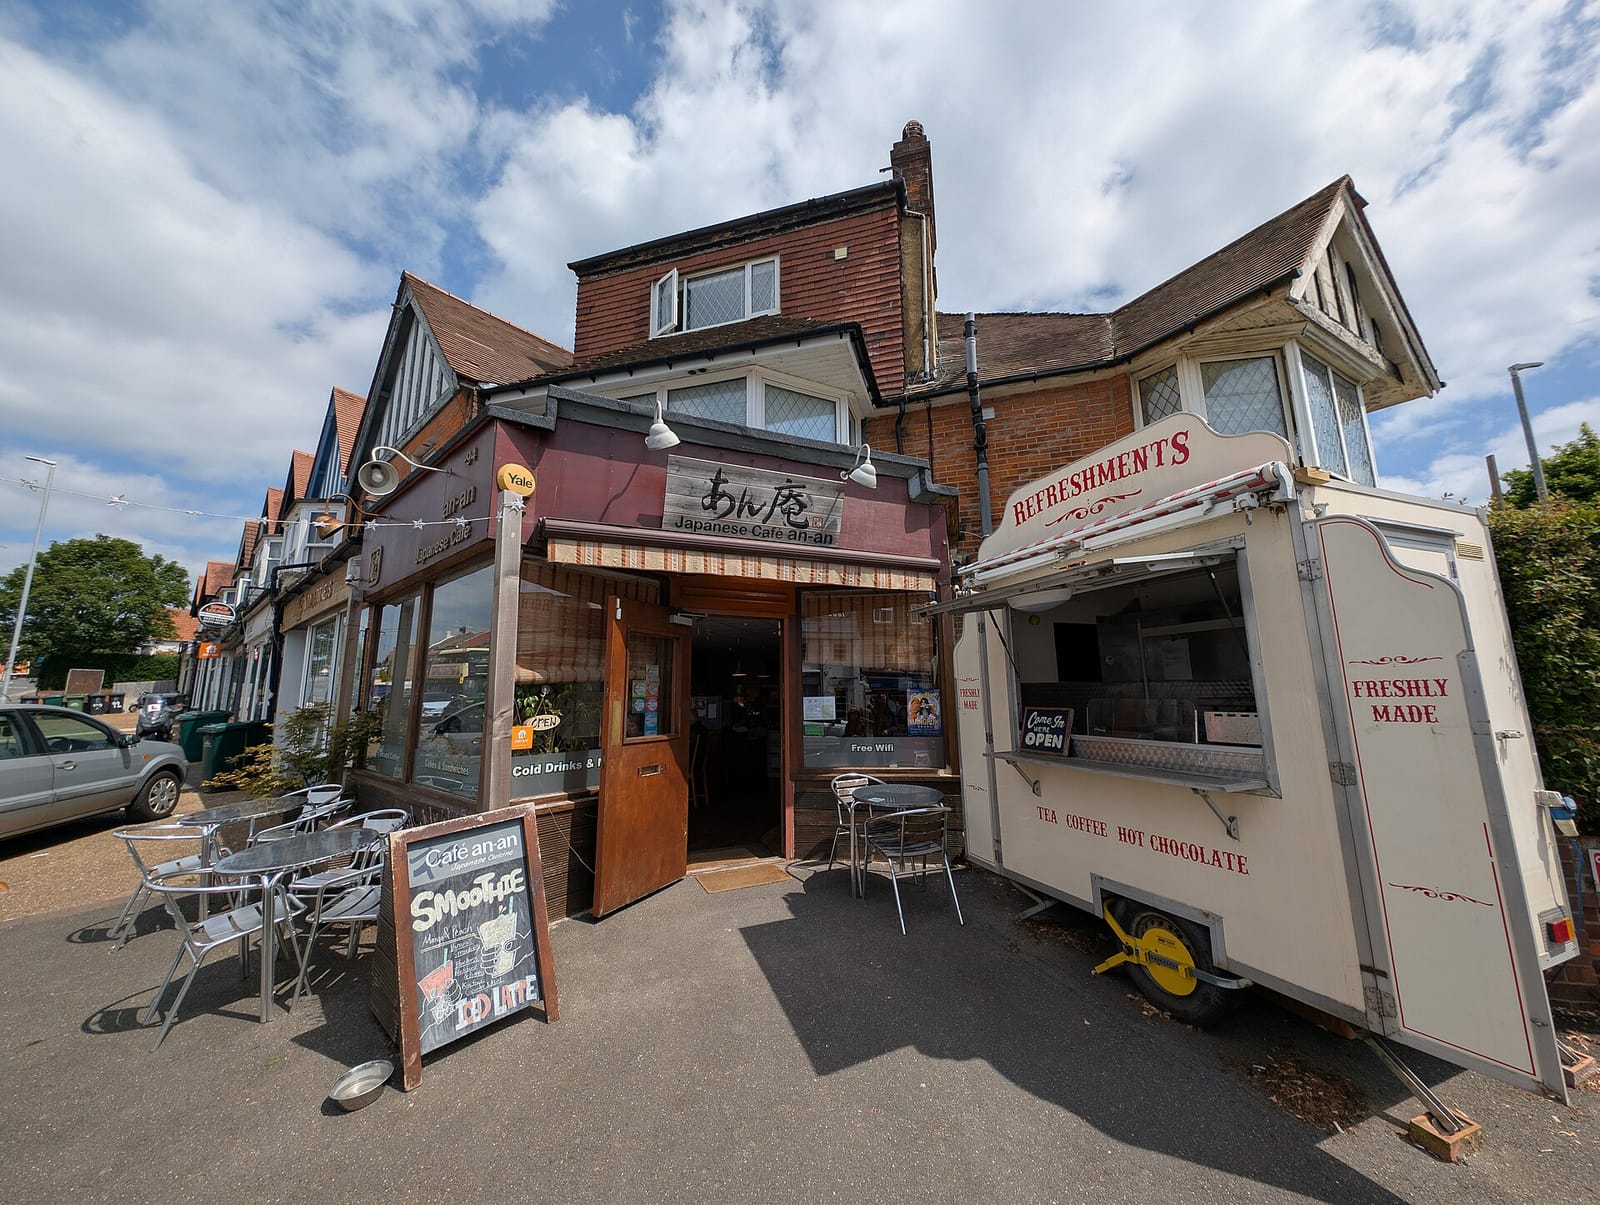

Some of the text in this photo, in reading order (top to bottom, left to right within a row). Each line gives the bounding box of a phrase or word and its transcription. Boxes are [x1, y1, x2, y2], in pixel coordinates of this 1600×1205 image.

[508, 472, 533, 489] Yale
[1013, 430, 1191, 527] REFRESHMENTS
[701, 467, 809, 529] あん庵
[675, 516, 833, 545] Japanese Café an-an
[415, 537, 449, 564] Japanese
[959, 688, 981, 698] FRESHLY
[1352, 678, 1448, 698] FRESHLY
[963, 700, 978, 710] MADE
[1371, 704, 1439, 723] MADE
[531, 716, 557, 728] OPEN
[1028, 711, 1065, 728] Come In
[851, 743, 894, 752] Free Wifi
[1025, 732, 1063, 749] OPEN
[512, 764, 541, 777] Cold
[545, 760, 583, 773] Drinks
[586, 758, 594, 768] &
[1037, 806, 1249, 875] TEA COFFEE HOT CHOCOLATE
[425, 843, 469, 868] Café
[451, 850, 514, 872] Japanese Cuisine
[455, 993, 492, 1031] ICED
[493, 974, 538, 1016] LATTE
